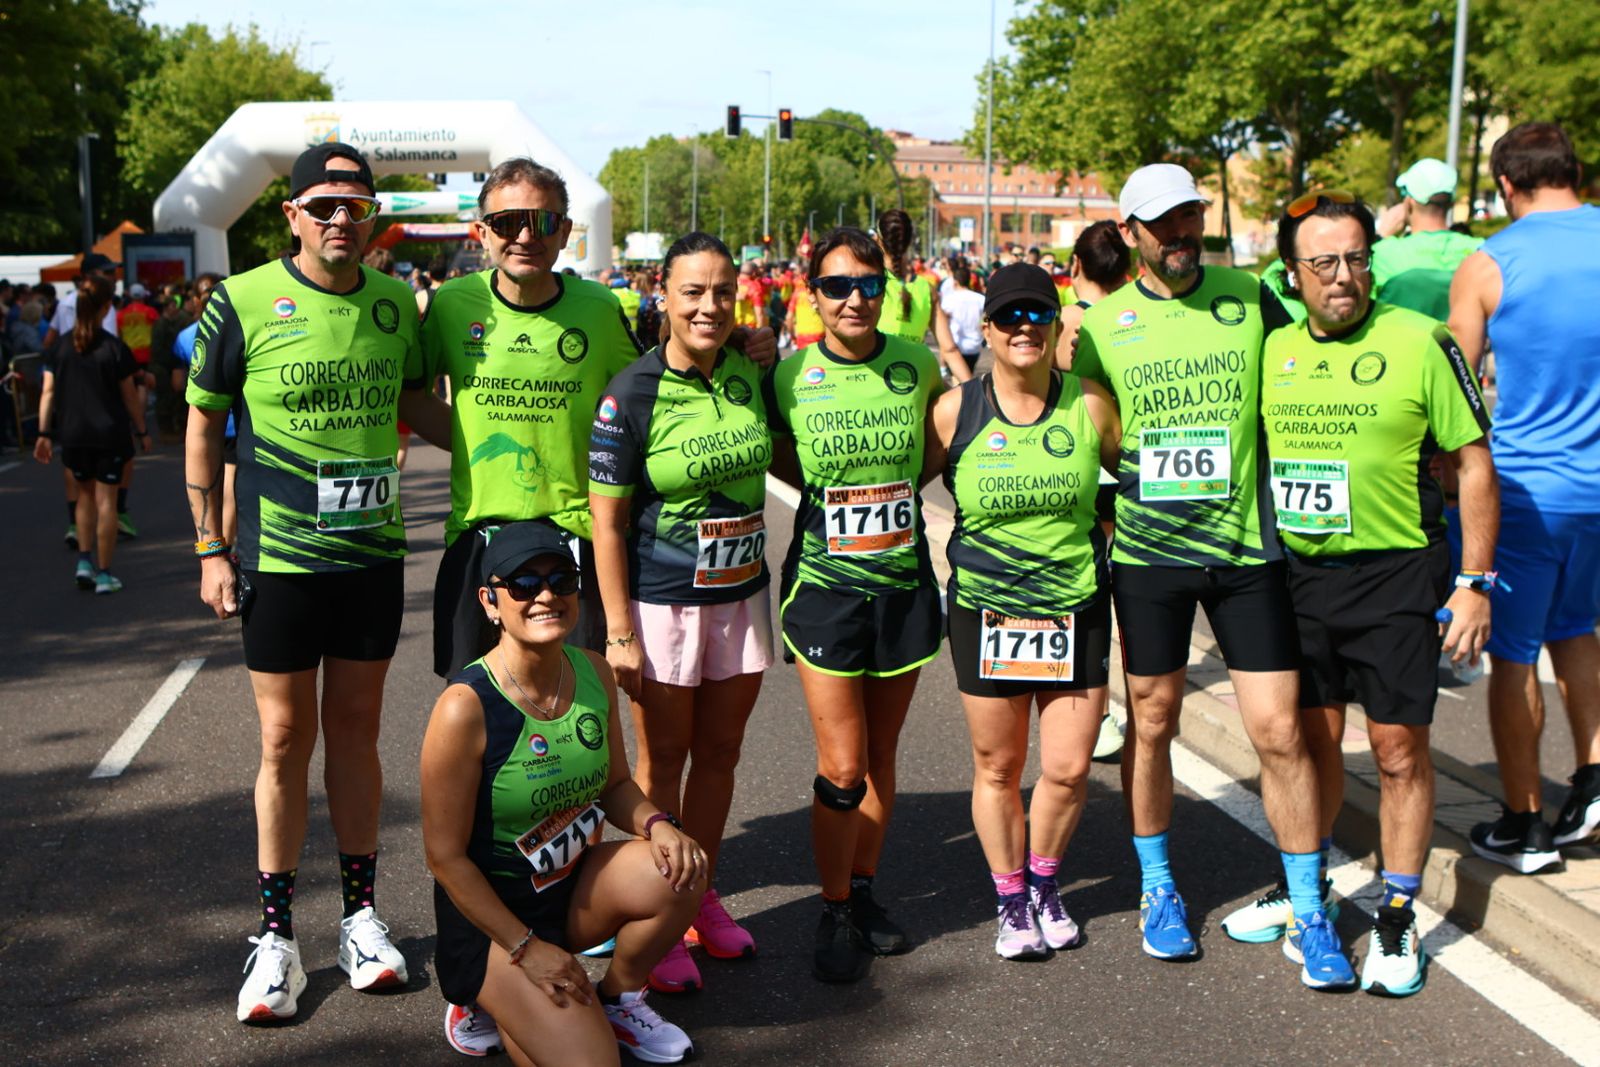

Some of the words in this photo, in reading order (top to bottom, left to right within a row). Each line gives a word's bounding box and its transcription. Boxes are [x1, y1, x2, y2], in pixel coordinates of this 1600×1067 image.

[350, 127, 456, 145] Ayuntamiento
[374, 147, 457, 162] Salamanca
[264, 317, 309, 328] CARBAJOSA
[280, 358, 398, 386] CORRECAMINOS
[1124, 350, 1247, 391] CORRECAMINOS
[463, 375, 583, 393] CORRECAMINOS
[282, 385, 396, 413] CARBAJOSA
[475, 393, 568, 410] CARBAJOSA
[1132, 378, 1243, 417] CARBAJOSA
[487, 411, 554, 423] SALAMANCA
[806, 405, 915, 434] CORRECAMINOS
[1141, 408, 1240, 430] SALAMANCA
[1267, 403, 1378, 417] CORRECAMINOS
[289, 412, 393, 432] SALAMANCA
[1274, 421, 1358, 435] CARBAJOSA
[812, 430, 915, 457] CARBAJOSA
[1143, 433, 1161, 446] XIV
[1283, 440, 1344, 451] SALAMANCA
[686, 444, 771, 480] CARBAJOS
[818, 454, 910, 472] SALAMANCA
[1153, 448, 1215, 479] 766
[694, 465, 767, 491] SALAMANC
[978, 472, 1081, 492] CORRECAMINOS
[333, 475, 390, 510] 770
[851, 493, 892, 503] CARRERA
[980, 491, 1078, 510] CARBAJOSA
[1280, 481, 1333, 513] 775
[831, 500, 912, 535] 1716
[702, 522, 723, 536] XIV
[704, 532, 765, 568] 1720
[987, 629, 1069, 660] 1719
[522, 754, 562, 767] CARBAJOSA
[531, 762, 609, 807] CORRECAMINO
[538, 807, 600, 873] 1717
